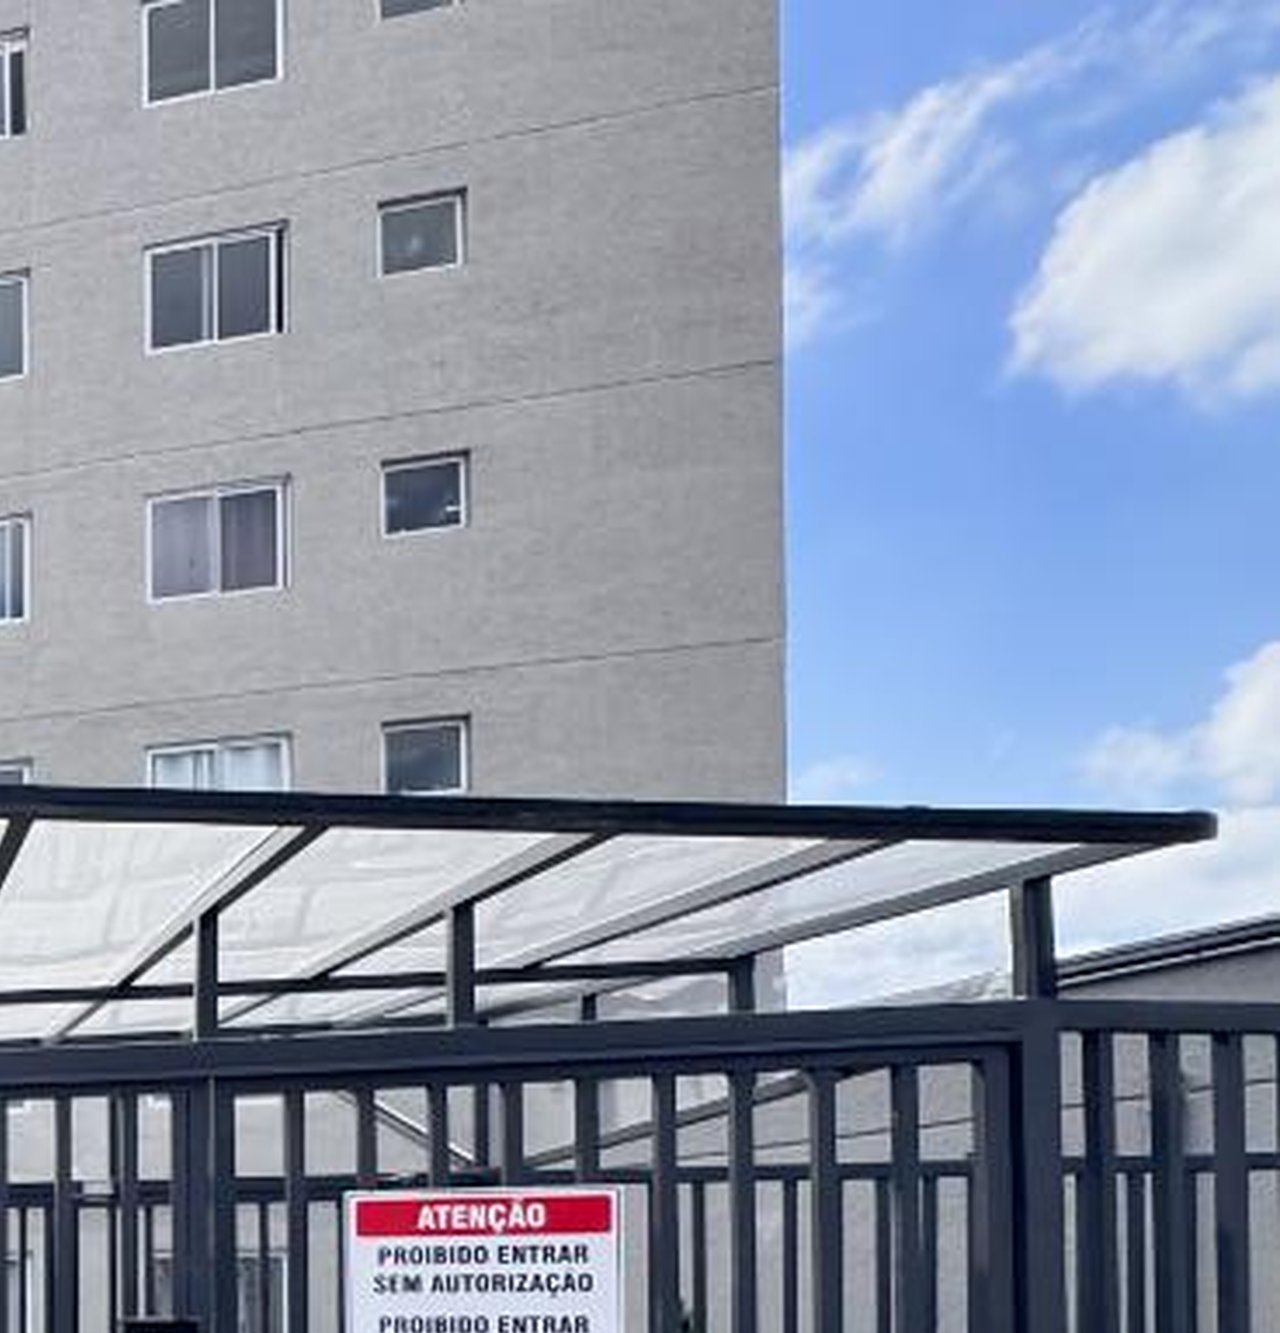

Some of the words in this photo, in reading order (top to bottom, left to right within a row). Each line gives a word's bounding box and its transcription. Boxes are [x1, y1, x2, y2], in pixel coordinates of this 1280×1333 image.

[416, 1200, 547, 1233] ATENÇÃO
[377, 1245, 489, 1266] PROIBIDO
[497, 1244, 590, 1265] ENTRAR
[373, 1273, 423, 1294] SEM
[429, 1271, 594, 1297] AUTORIZAÇÃO
